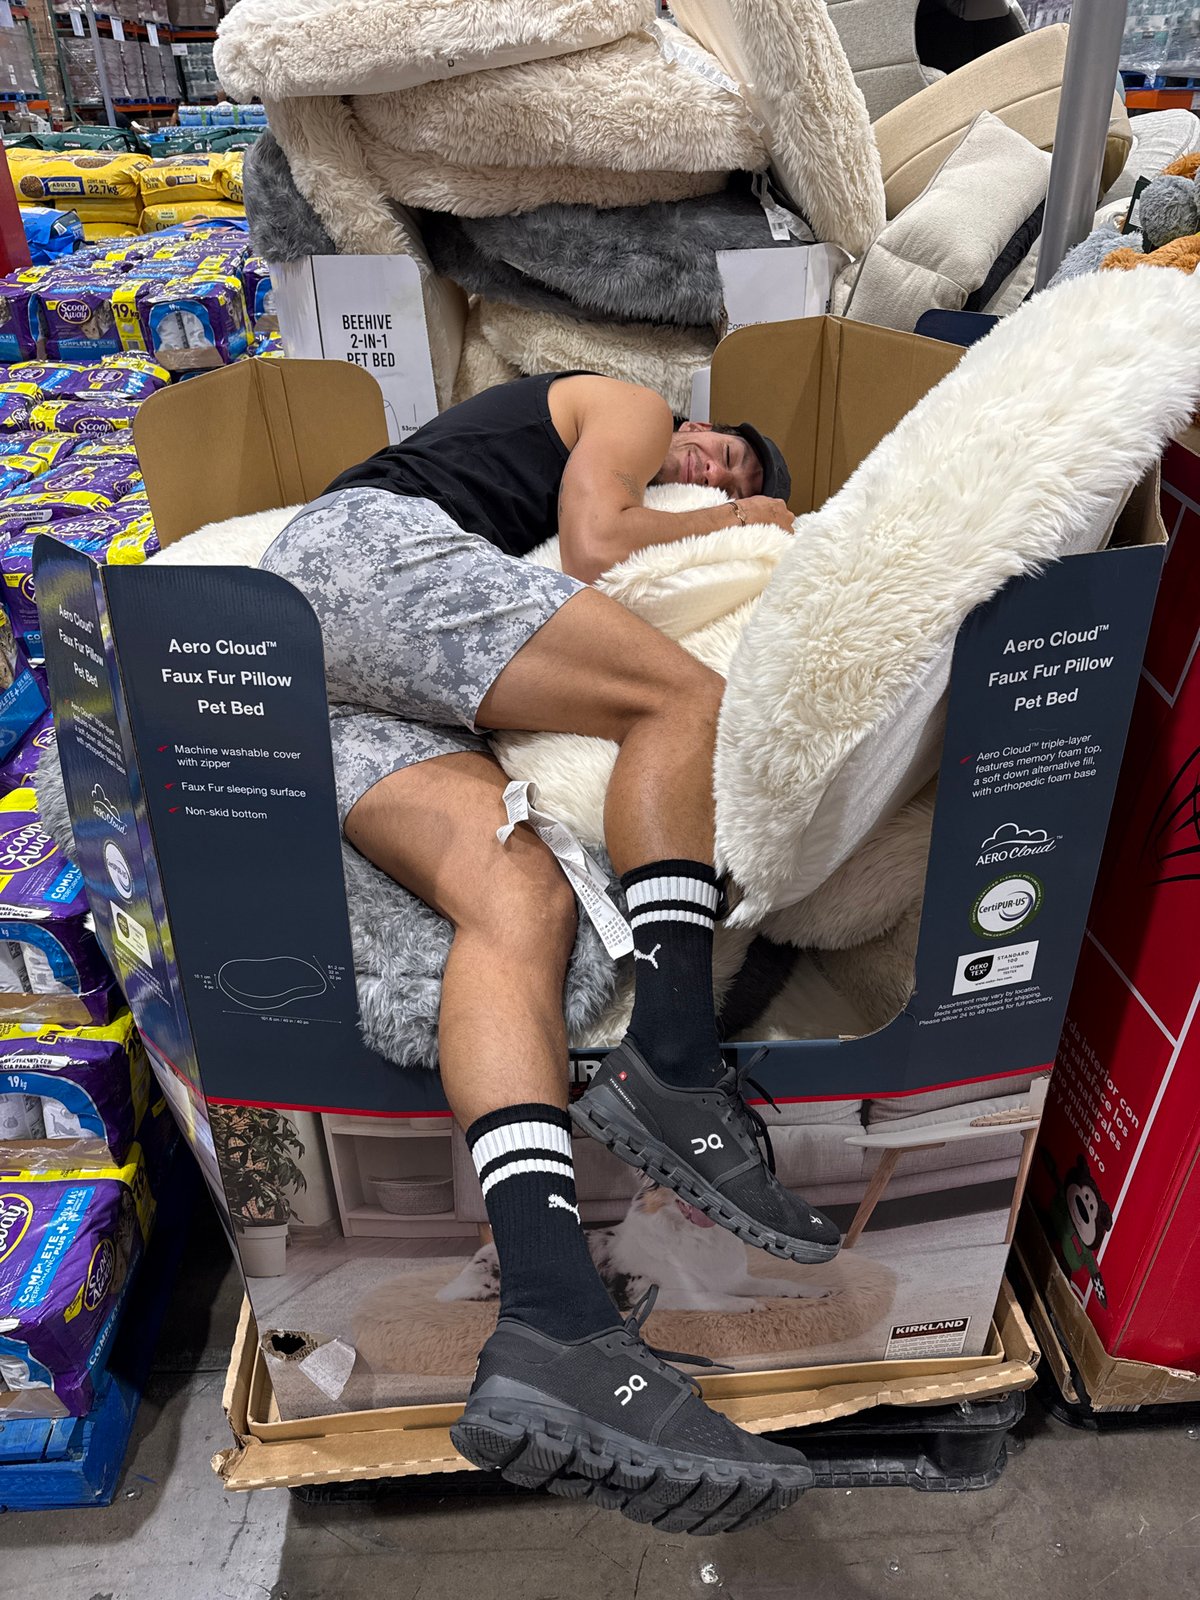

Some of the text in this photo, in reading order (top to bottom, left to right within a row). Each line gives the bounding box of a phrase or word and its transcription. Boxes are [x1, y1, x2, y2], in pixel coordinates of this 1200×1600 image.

[227, 180, 243, 194] CAN
[61, 303, 88, 313] Scoop
[63, 311, 87, 320] Away
[113, 303, 140, 320] 19 kg
[342, 314, 393, 330] BEEHIVE
[350, 333, 388, 349] 2-IN-1
[347, 352, 396, 367] PET BED
[79, 421, 110, 432] Scoop
[59, 603, 74, 623] Aero
[58, 628, 104, 667] Faux Fur Pillow
[169, 638, 277, 656] Aero Cloud™
[1003, 624, 1110, 655] Aero Cloud™
[73, 661, 98, 688] Pet Bed
[161, 668, 292, 687] Faux Fur Pillow
[988, 656, 1114, 687] Faux Fur Pillow
[198, 700, 265, 716] Pet Bed
[1014, 688, 1079, 711] Pet Bed
[174, 744, 301, 760] Machine washable cover
[976, 733, 1092, 762] Aero Cloud™ triple-layer
[177, 758, 231, 769] with zipper
[975, 745, 1103, 774] features memory foam top,
[973, 756, 1096, 786] a soft down alternative fill,
[181, 782, 307, 798] Faux Fur sleeping surface
[971, 768, 1097, 798] with orthopedic foam base
[185, 806, 268, 820] Non-skid bottom
[16, 834, 52, 868] Awa
[975, 851, 1009, 867] AERO
[51, 864, 80, 900] COMPL
[996, 950, 1030, 961] STANDARD
[969, 962, 989, 971] OEKO
[933, 1010, 951, 1018] Beds
[963, 998, 1003, 1011] compressed
[1004, 996, 1013, 1004] for
[937, 997, 975, 1011] Assortment
[975, 995, 990, 1004] may
[990, 993, 1004, 1001] vary
[918, 1018, 941, 1026] Please
[941, 1014, 959, 1022] allow
[986, 1005, 1005, 1014] hours
[7, 1075, 27, 1091] 19 kg
[1081, 1036, 1119, 1096] interior
[1119, 1098, 1140, 1129] con
[1070, 1046, 1112, 1113] satisface
[1112, 1107, 1129, 1138] los
[1077, 1079, 1121, 1151] naturales
[1064, 1104, 1105, 1173] duradero
[895, 1319, 965, 1335] KIRKLAND
